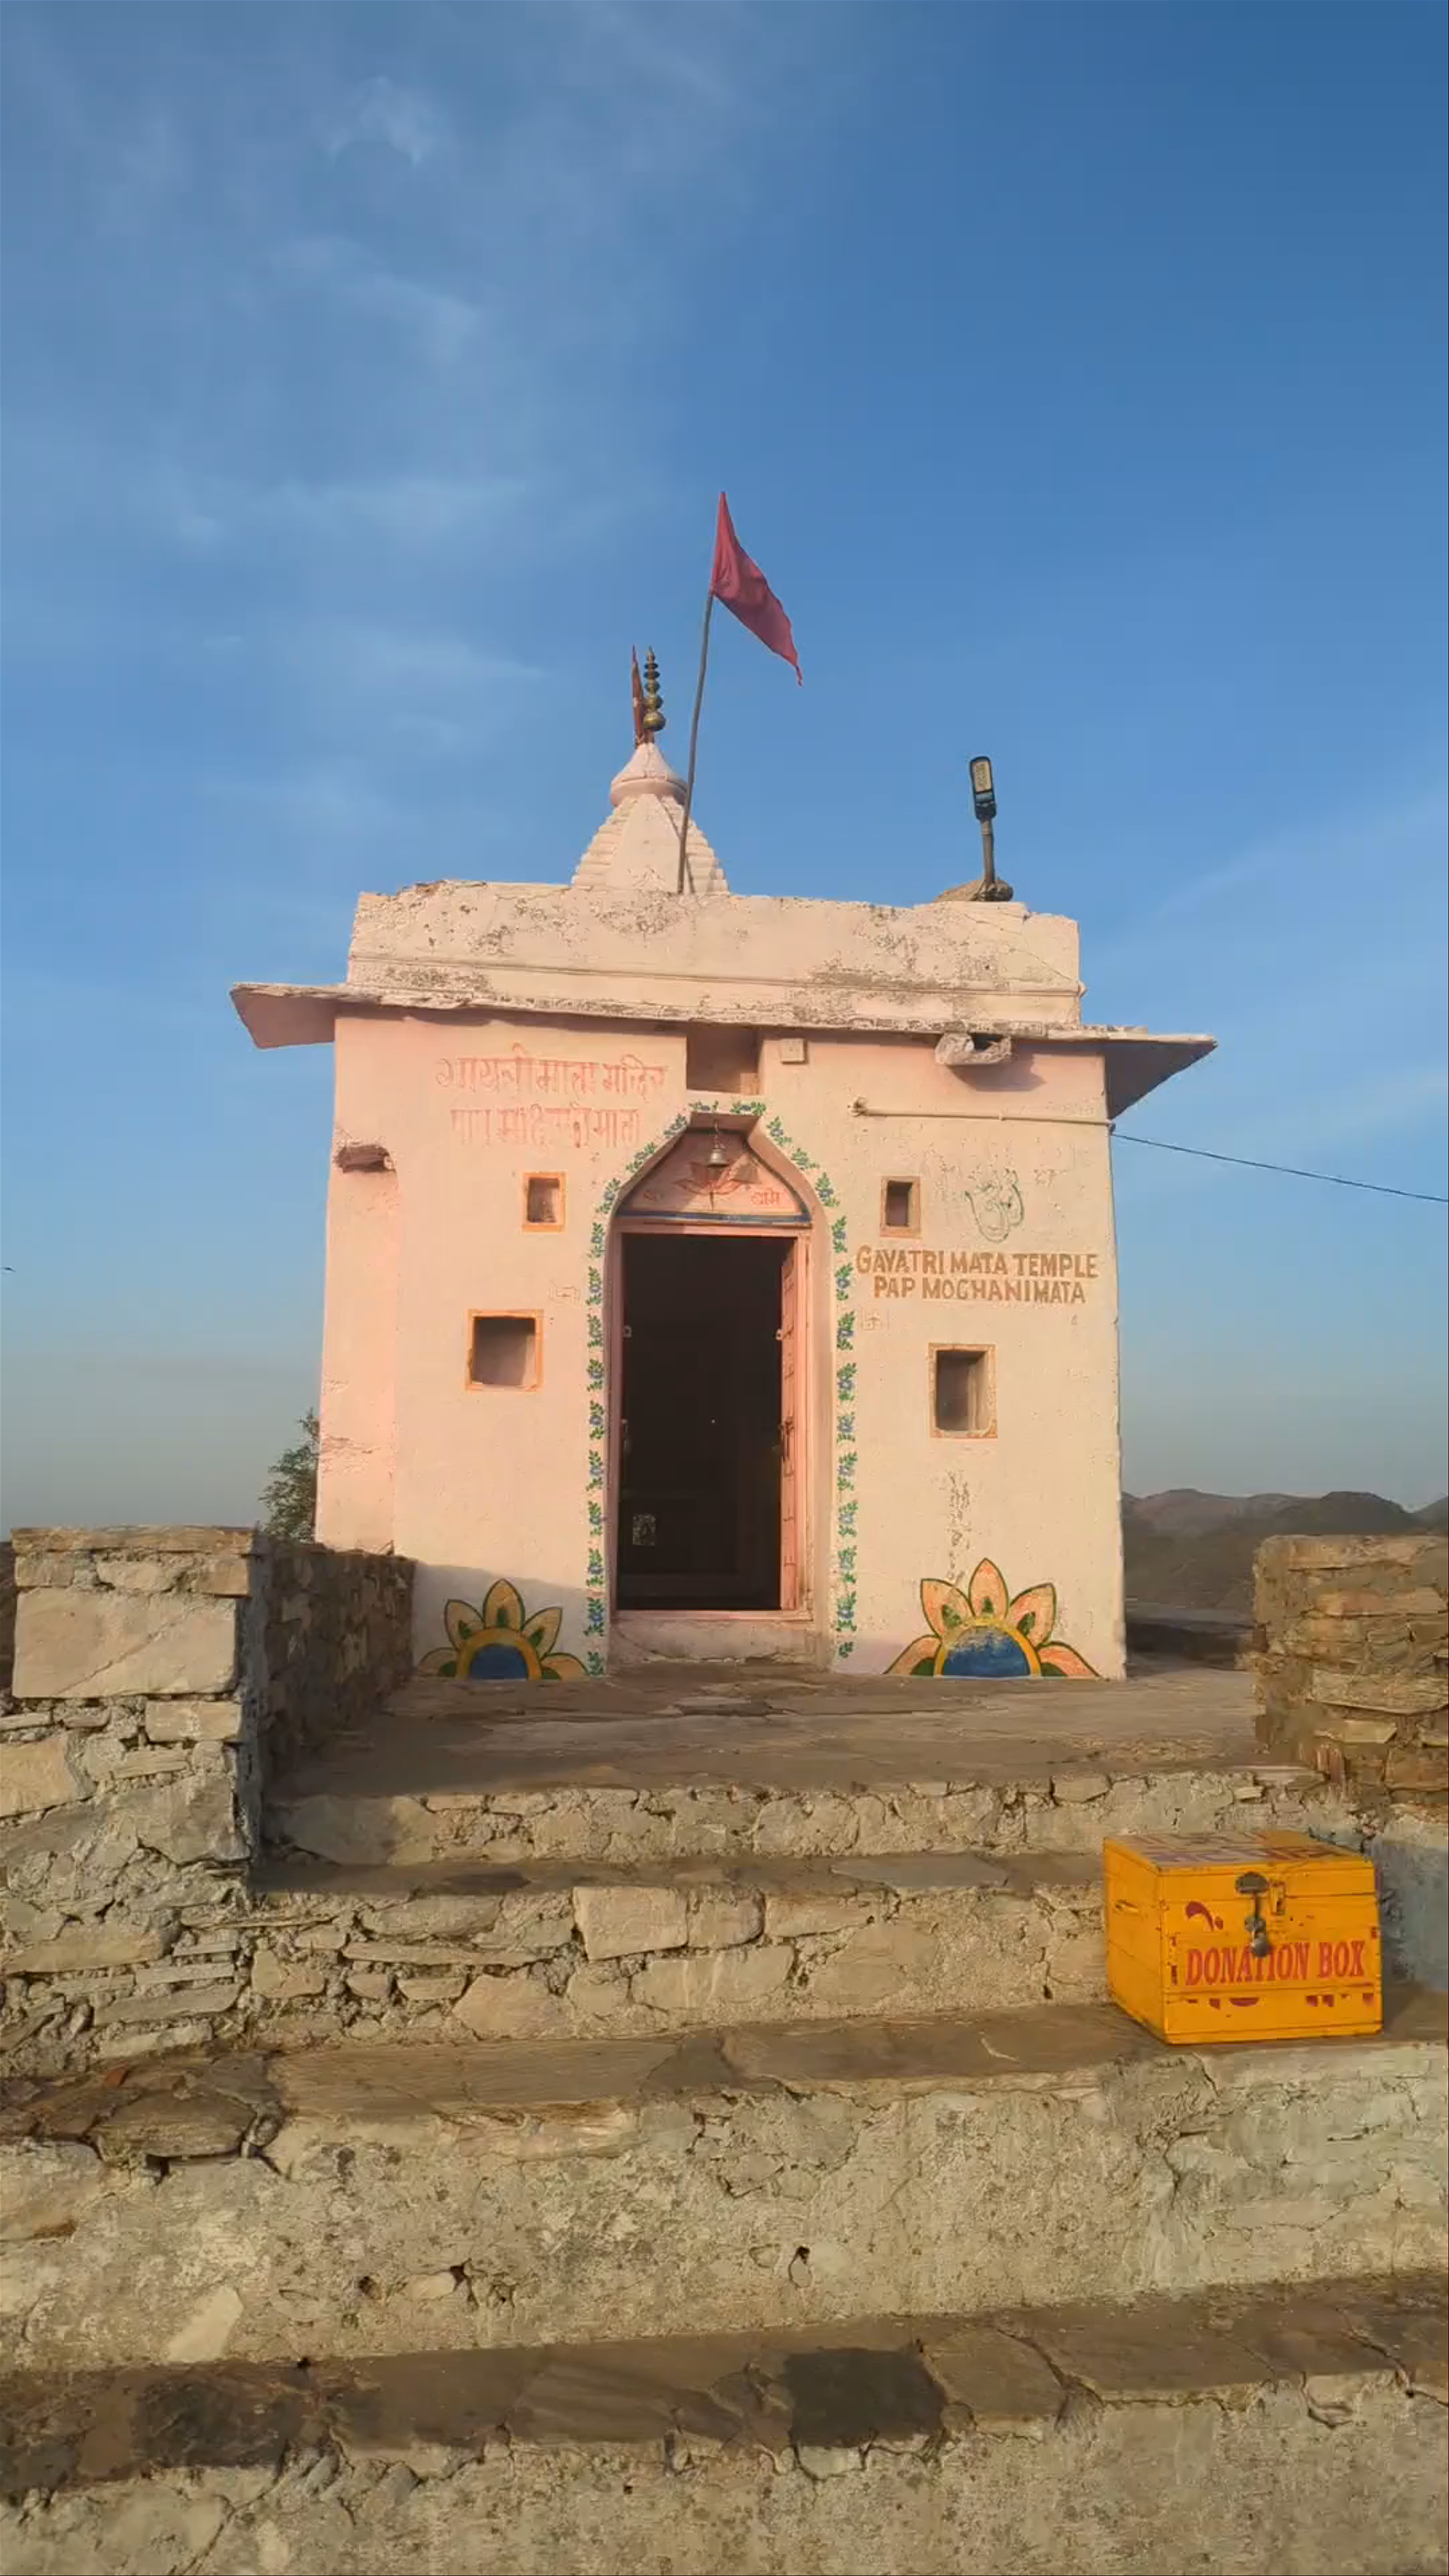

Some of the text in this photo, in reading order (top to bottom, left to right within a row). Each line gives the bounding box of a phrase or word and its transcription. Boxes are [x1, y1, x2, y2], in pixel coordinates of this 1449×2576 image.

[856, 1244, 1099, 1278] GAYATRI MATA TEMPLE
[874, 1275, 916, 1299] PAP
[1185, 1939, 1365, 1986] DONATION BOX
